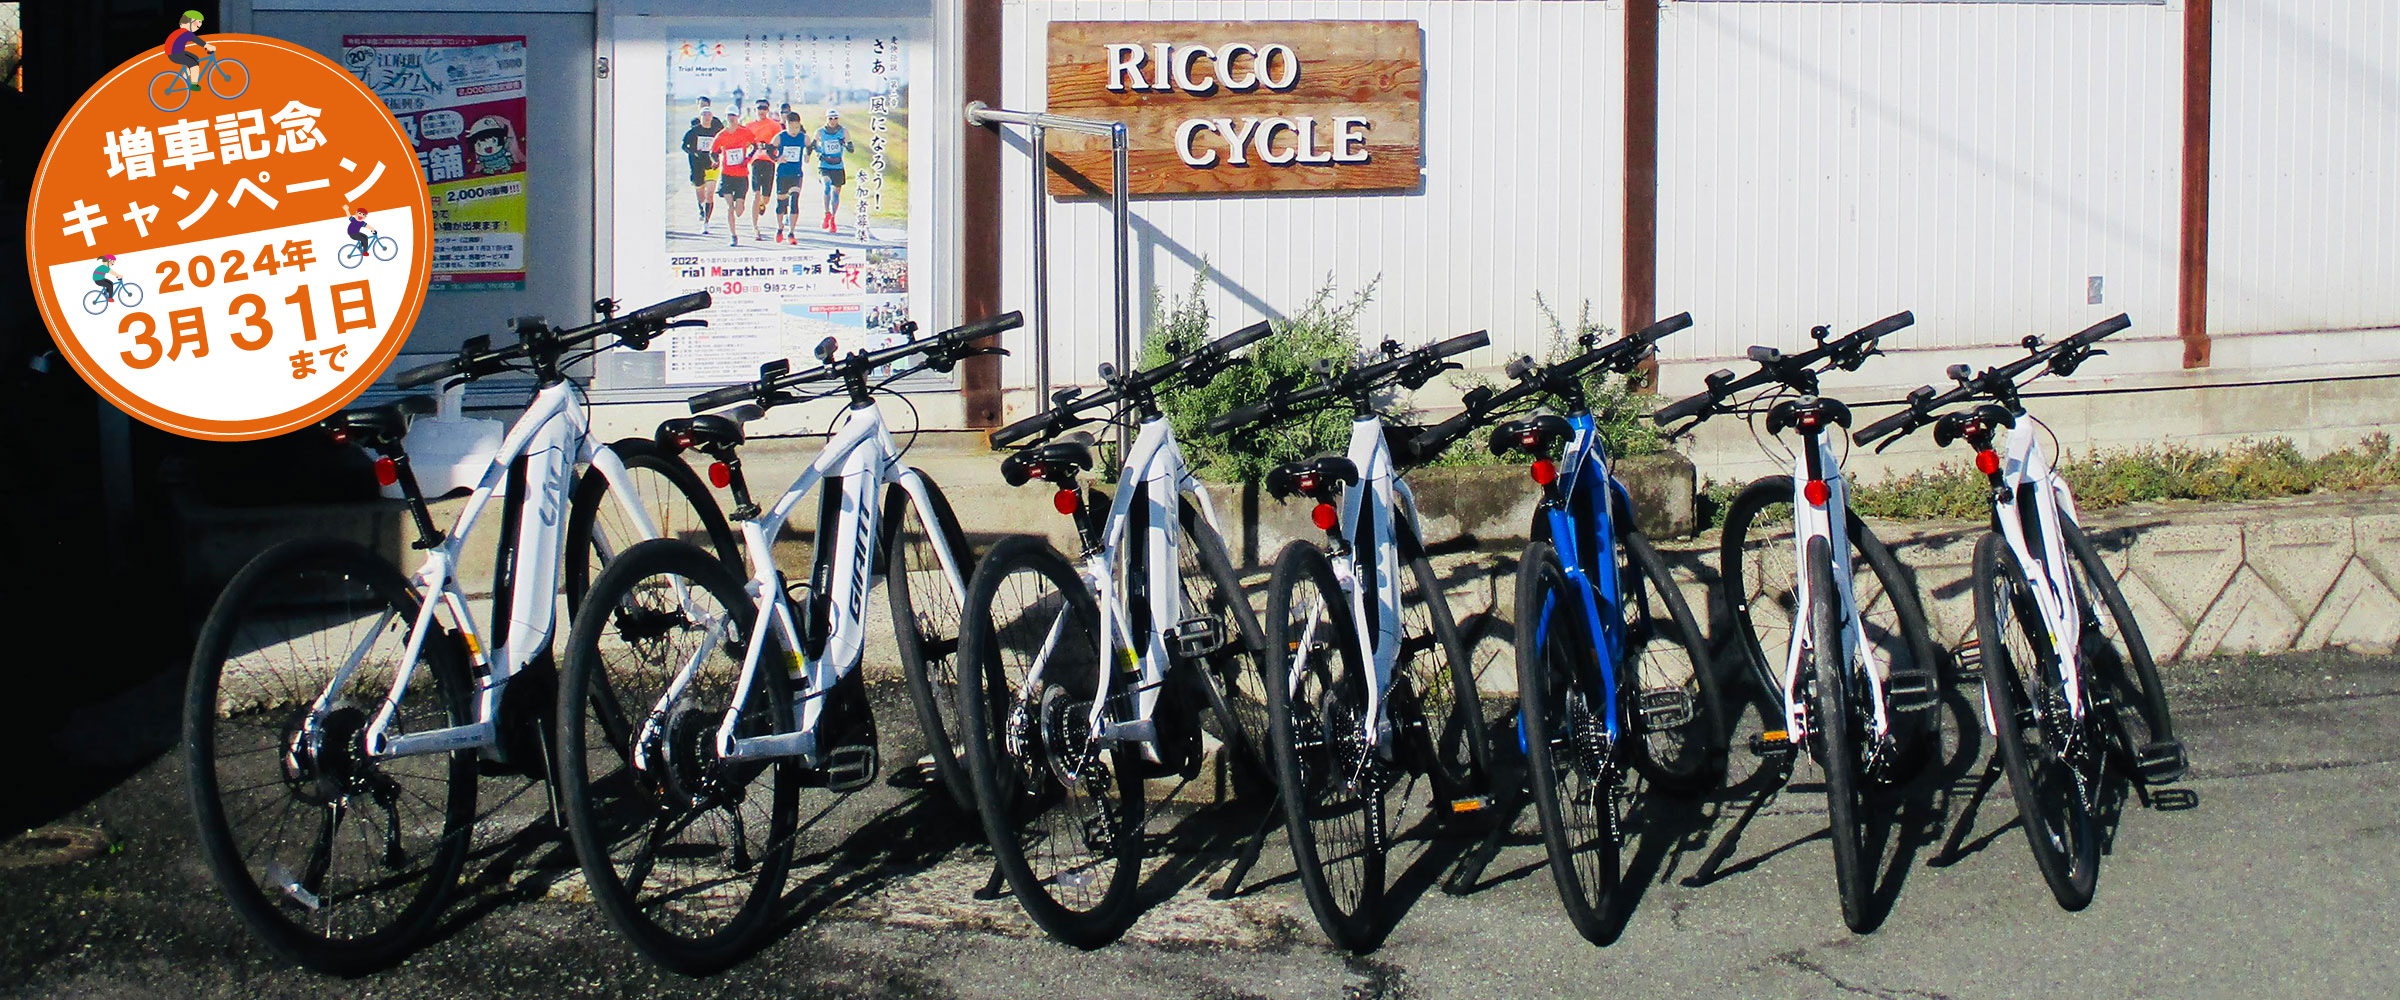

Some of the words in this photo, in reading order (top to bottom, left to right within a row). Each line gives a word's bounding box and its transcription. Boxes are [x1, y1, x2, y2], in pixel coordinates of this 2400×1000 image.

[1105, 42, 1298, 91] RICCO
[1175, 116, 1369, 166] CYCLE
[671, 257, 699, 265] 2022
[671, 266, 705, 278] Trial
[711, 265, 775, 277] Marathon
